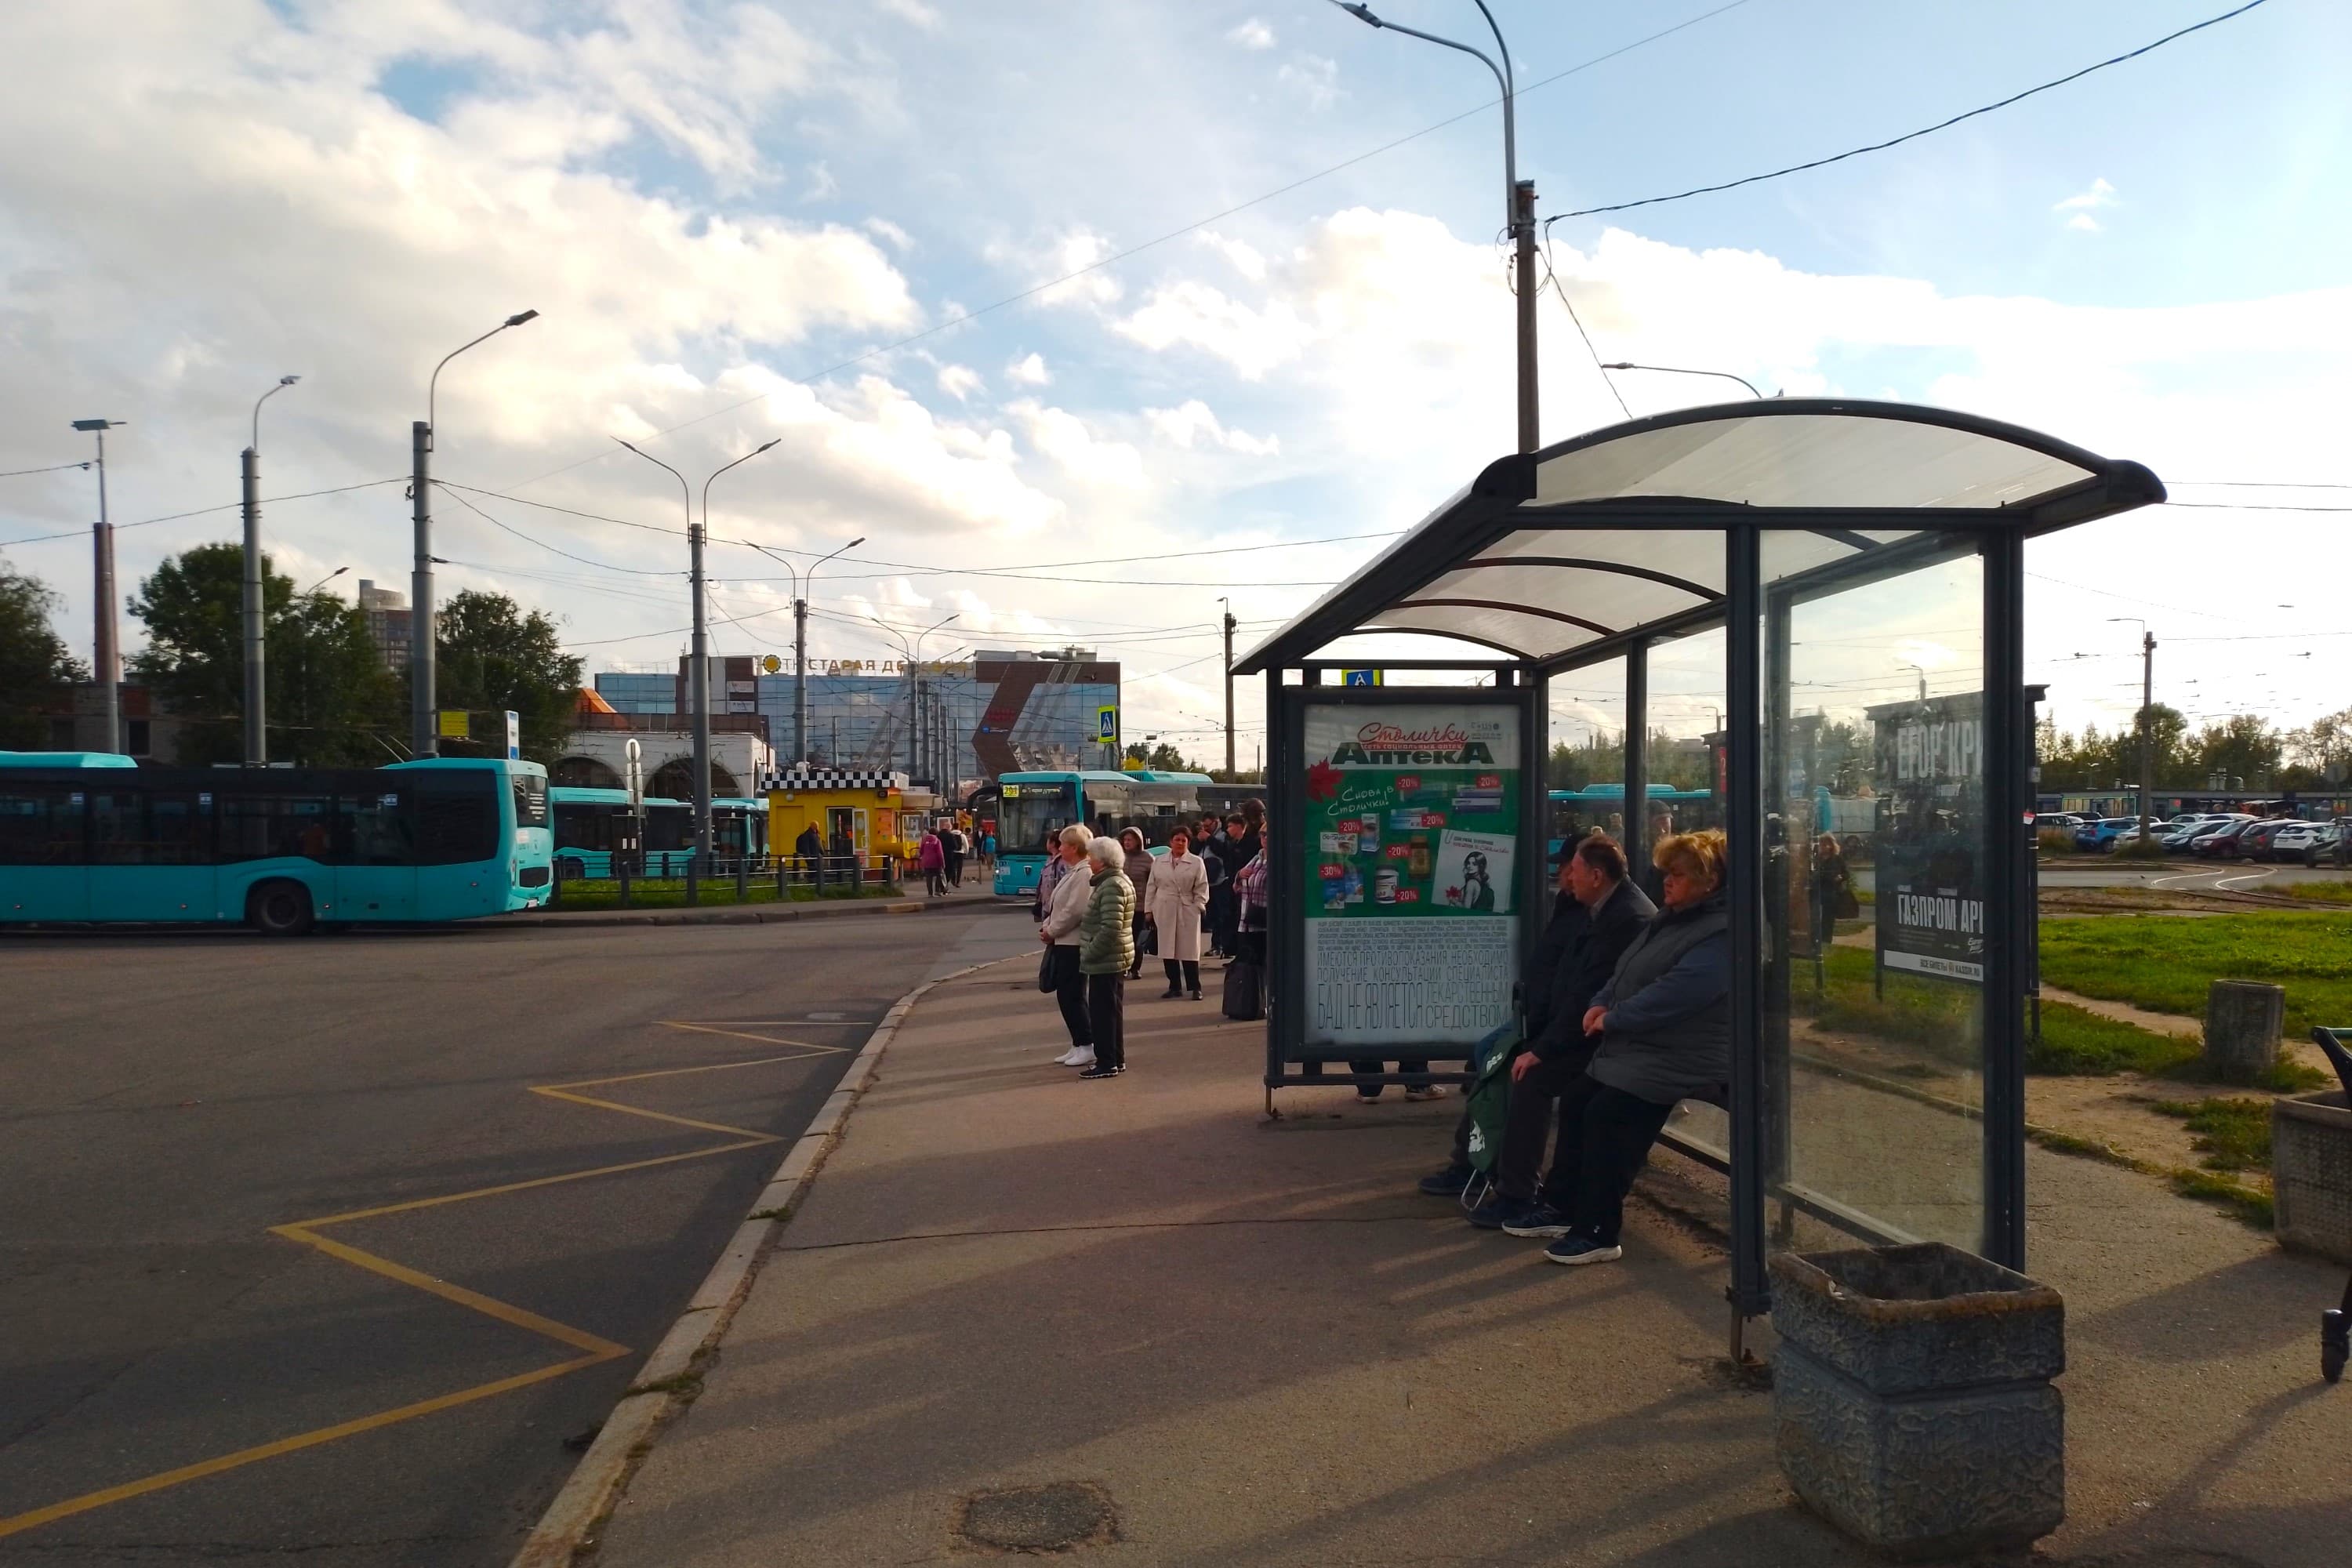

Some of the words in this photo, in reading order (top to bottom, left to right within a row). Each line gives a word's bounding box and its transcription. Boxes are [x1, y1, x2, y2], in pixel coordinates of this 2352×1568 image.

[808, 659, 875, 670] СТАРАЯ
[1357, 722, 1469, 742] Столички
[1898, 894, 1957, 931] ГАЗПРОМ
[1318, 951, 1357, 967] ИМЕЮТСЯ
[1451, 949, 1508, 967] НЕОБХОДИМО
[1317, 967, 1368, 982] ПОЛУЧЕНИЕ
[1374, 967, 1441, 981] КОНСУЛЬТАЦИИ
[1447, 965, 1508, 981] СПЕЦИАЛИСТА
[1348, 983, 1363, 1029] НЕ
[1365, 982, 1423, 1029] ЯВЛЯЕТСЯ
